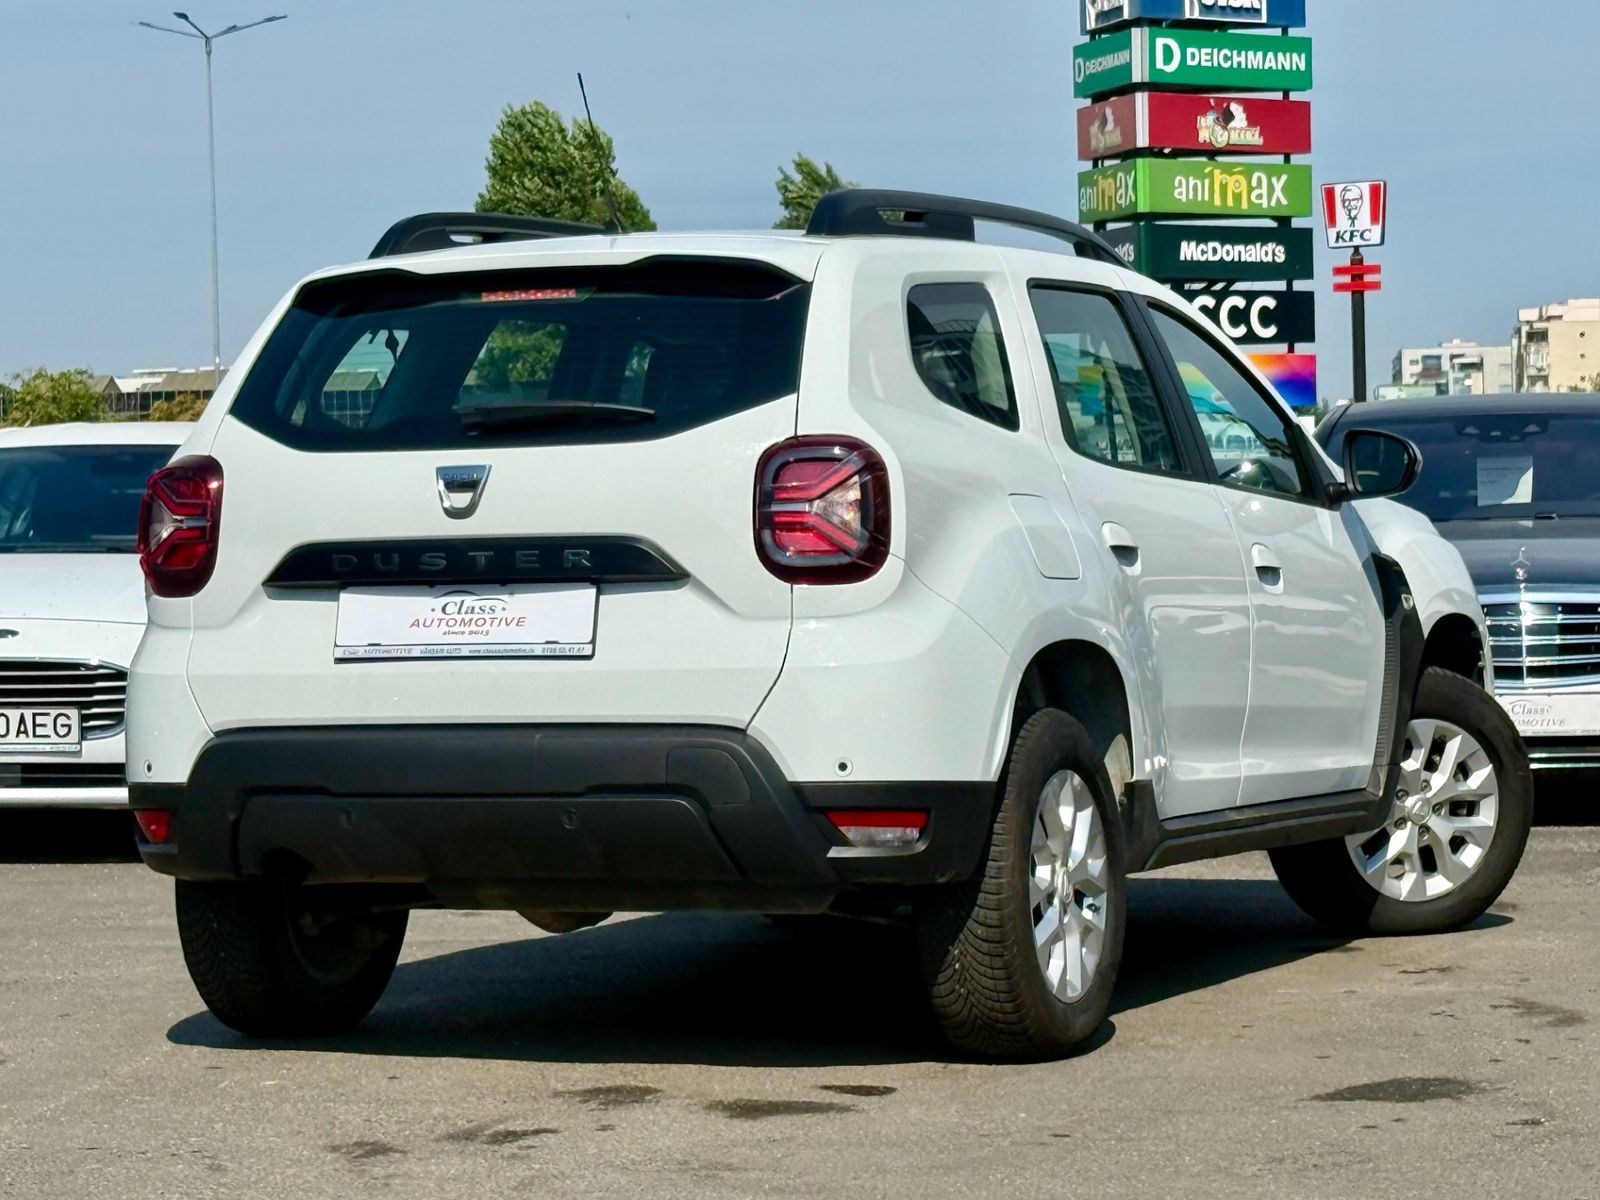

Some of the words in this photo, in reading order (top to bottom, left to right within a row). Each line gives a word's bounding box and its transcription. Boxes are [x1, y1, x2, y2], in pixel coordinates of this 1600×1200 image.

[1085, 48, 1130, 76] DEICHMANN
[1185, 46, 1306, 72] DEICHMANN
[1173, 167, 1288, 210] animax
[1334, 228, 1372, 244] KFC
[1179, 240, 1286, 264] McDonald's
[331, 549, 594, 572] DUSTER
[441, 599, 498, 616] Class
[409, 616, 528, 629] AUTOMOTIVE
